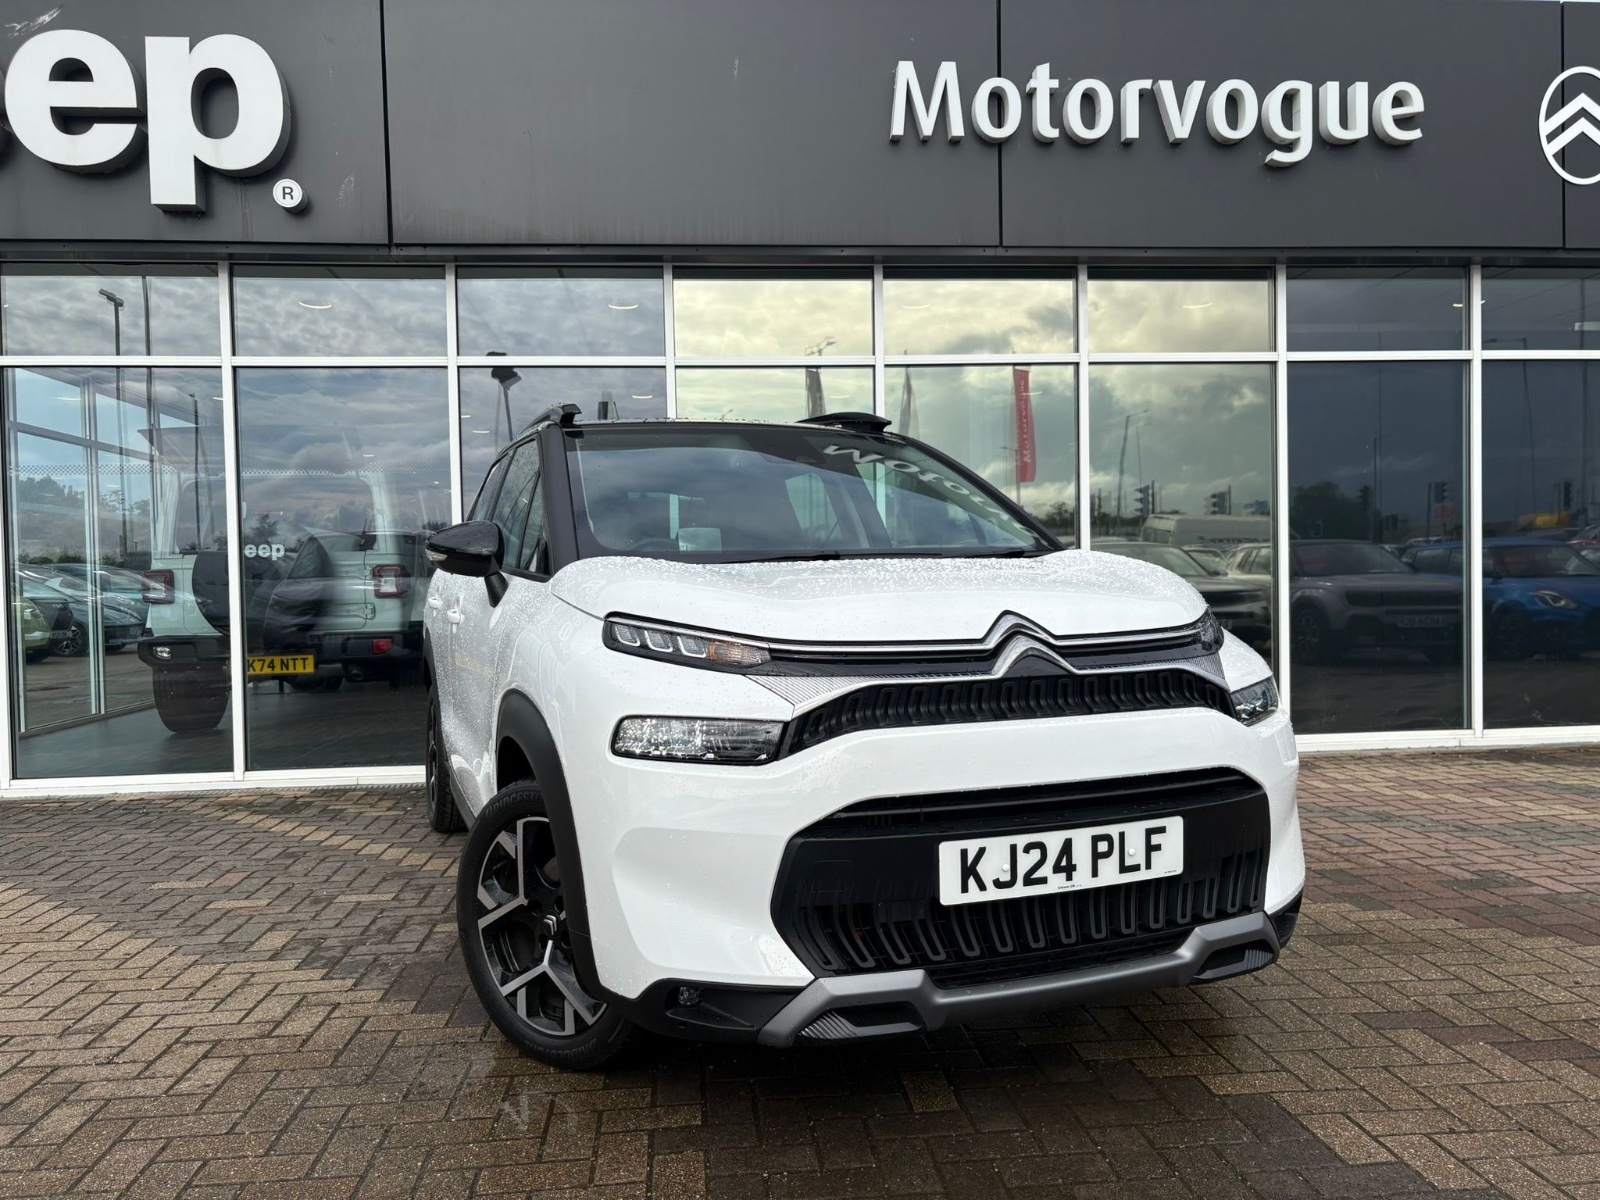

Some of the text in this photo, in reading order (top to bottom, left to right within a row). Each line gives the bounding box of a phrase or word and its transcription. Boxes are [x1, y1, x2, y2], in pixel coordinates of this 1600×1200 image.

[1, 29, 290, 210] ep
[890, 61, 1424, 166] Motorvogue
[245, 543, 285, 561] eep
[247, 657, 308, 672] K74 NTT
[960, 826, 1167, 894] KJ24 PLF
